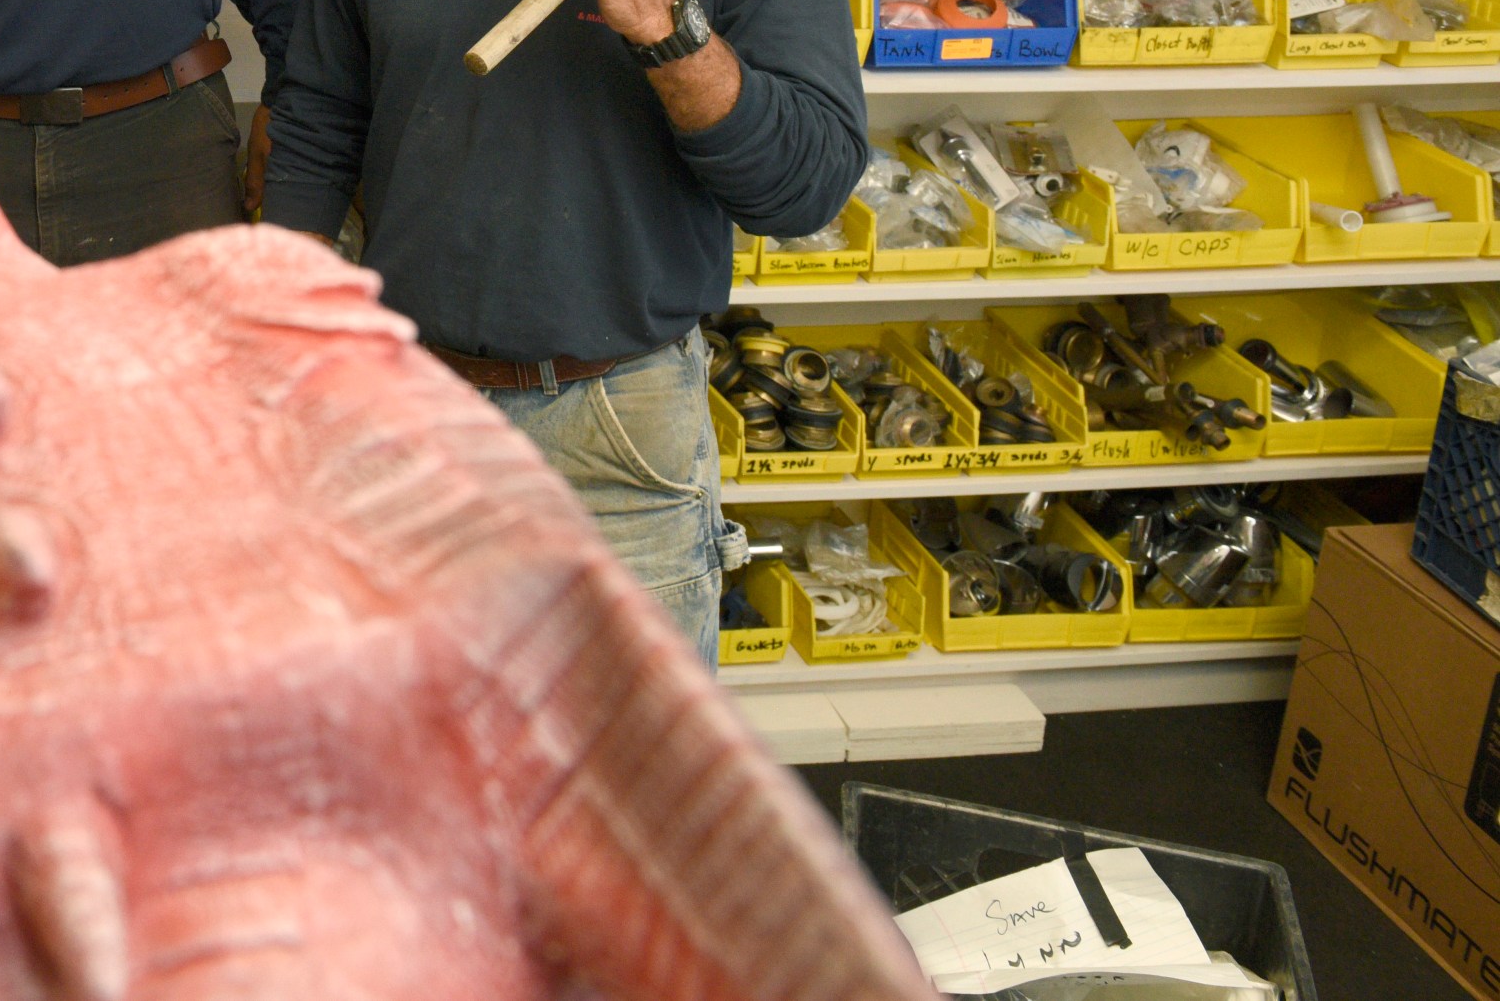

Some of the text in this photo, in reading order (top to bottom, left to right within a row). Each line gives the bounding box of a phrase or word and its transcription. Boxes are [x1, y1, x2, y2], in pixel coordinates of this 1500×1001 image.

[878, 37, 925, 57] TANK
[1019, 39, 1066, 57] BOWL
[1178, 237, 1232, 256] CAPS
